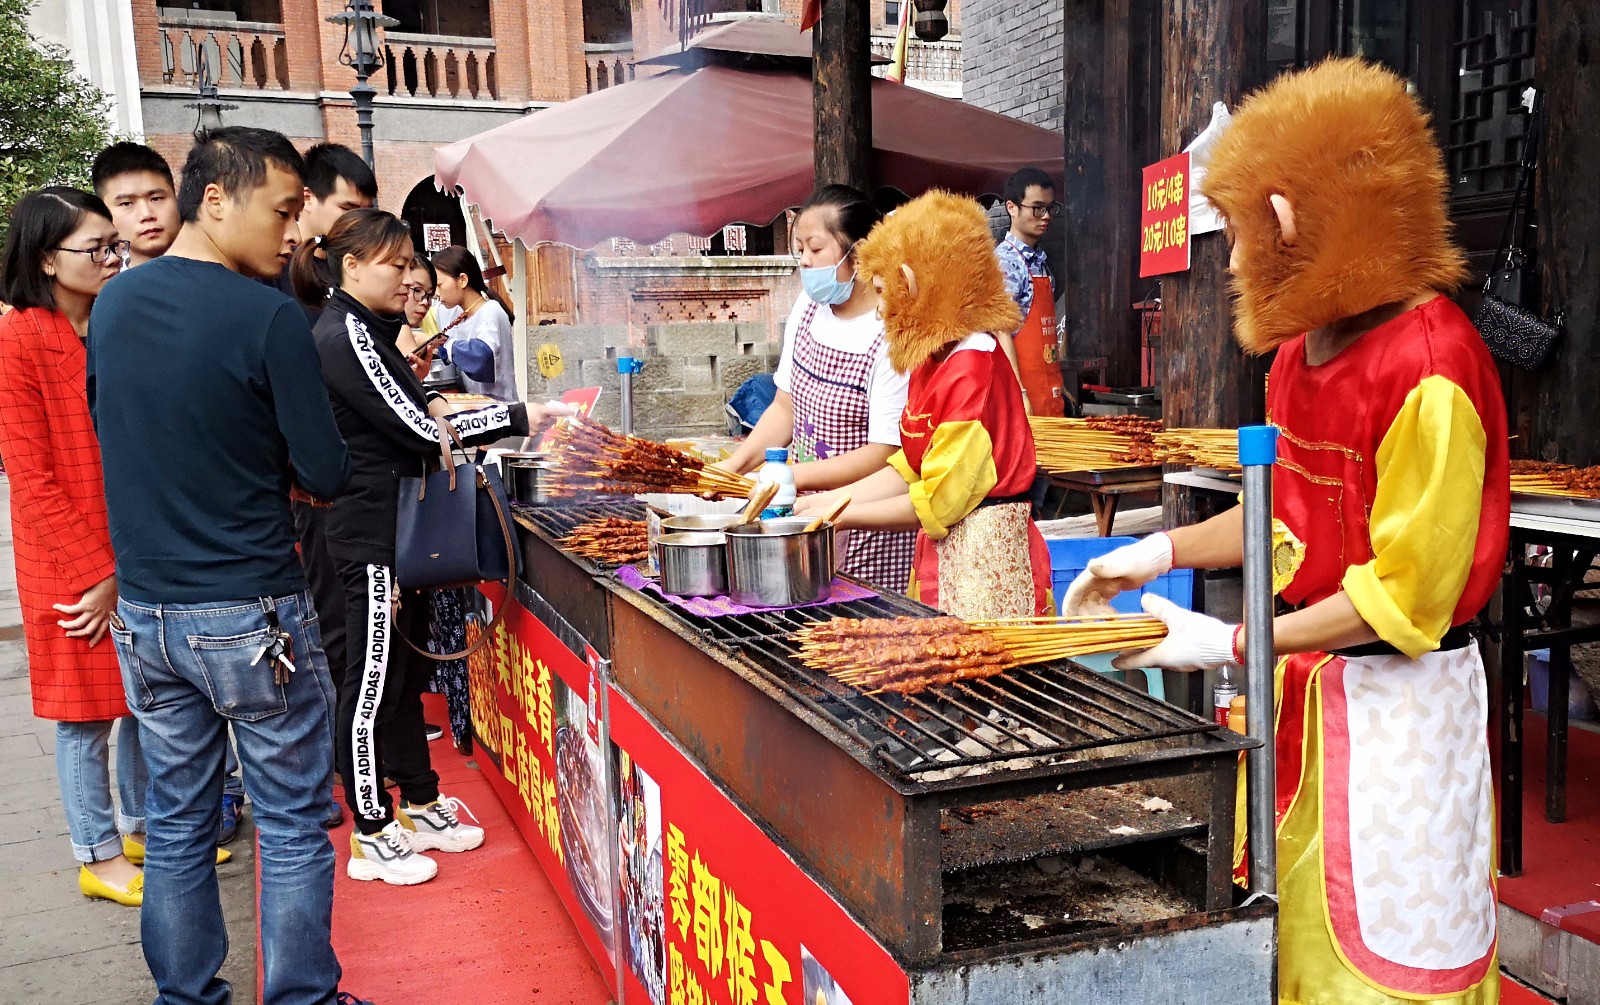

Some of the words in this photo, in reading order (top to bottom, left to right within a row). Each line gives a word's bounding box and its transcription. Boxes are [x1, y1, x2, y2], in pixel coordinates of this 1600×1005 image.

[1147, 171, 1184, 211] 10元/4串
[1143, 212, 1186, 254] 20元/10串
[368, 359, 405, 405] ADIDAS
[373, 611, 386, 663] ADIDAS
[361, 670, 381, 720] ADIDAS
[495, 617, 553, 758] 美味佳肴
[356, 727, 371, 777] ADIDAS
